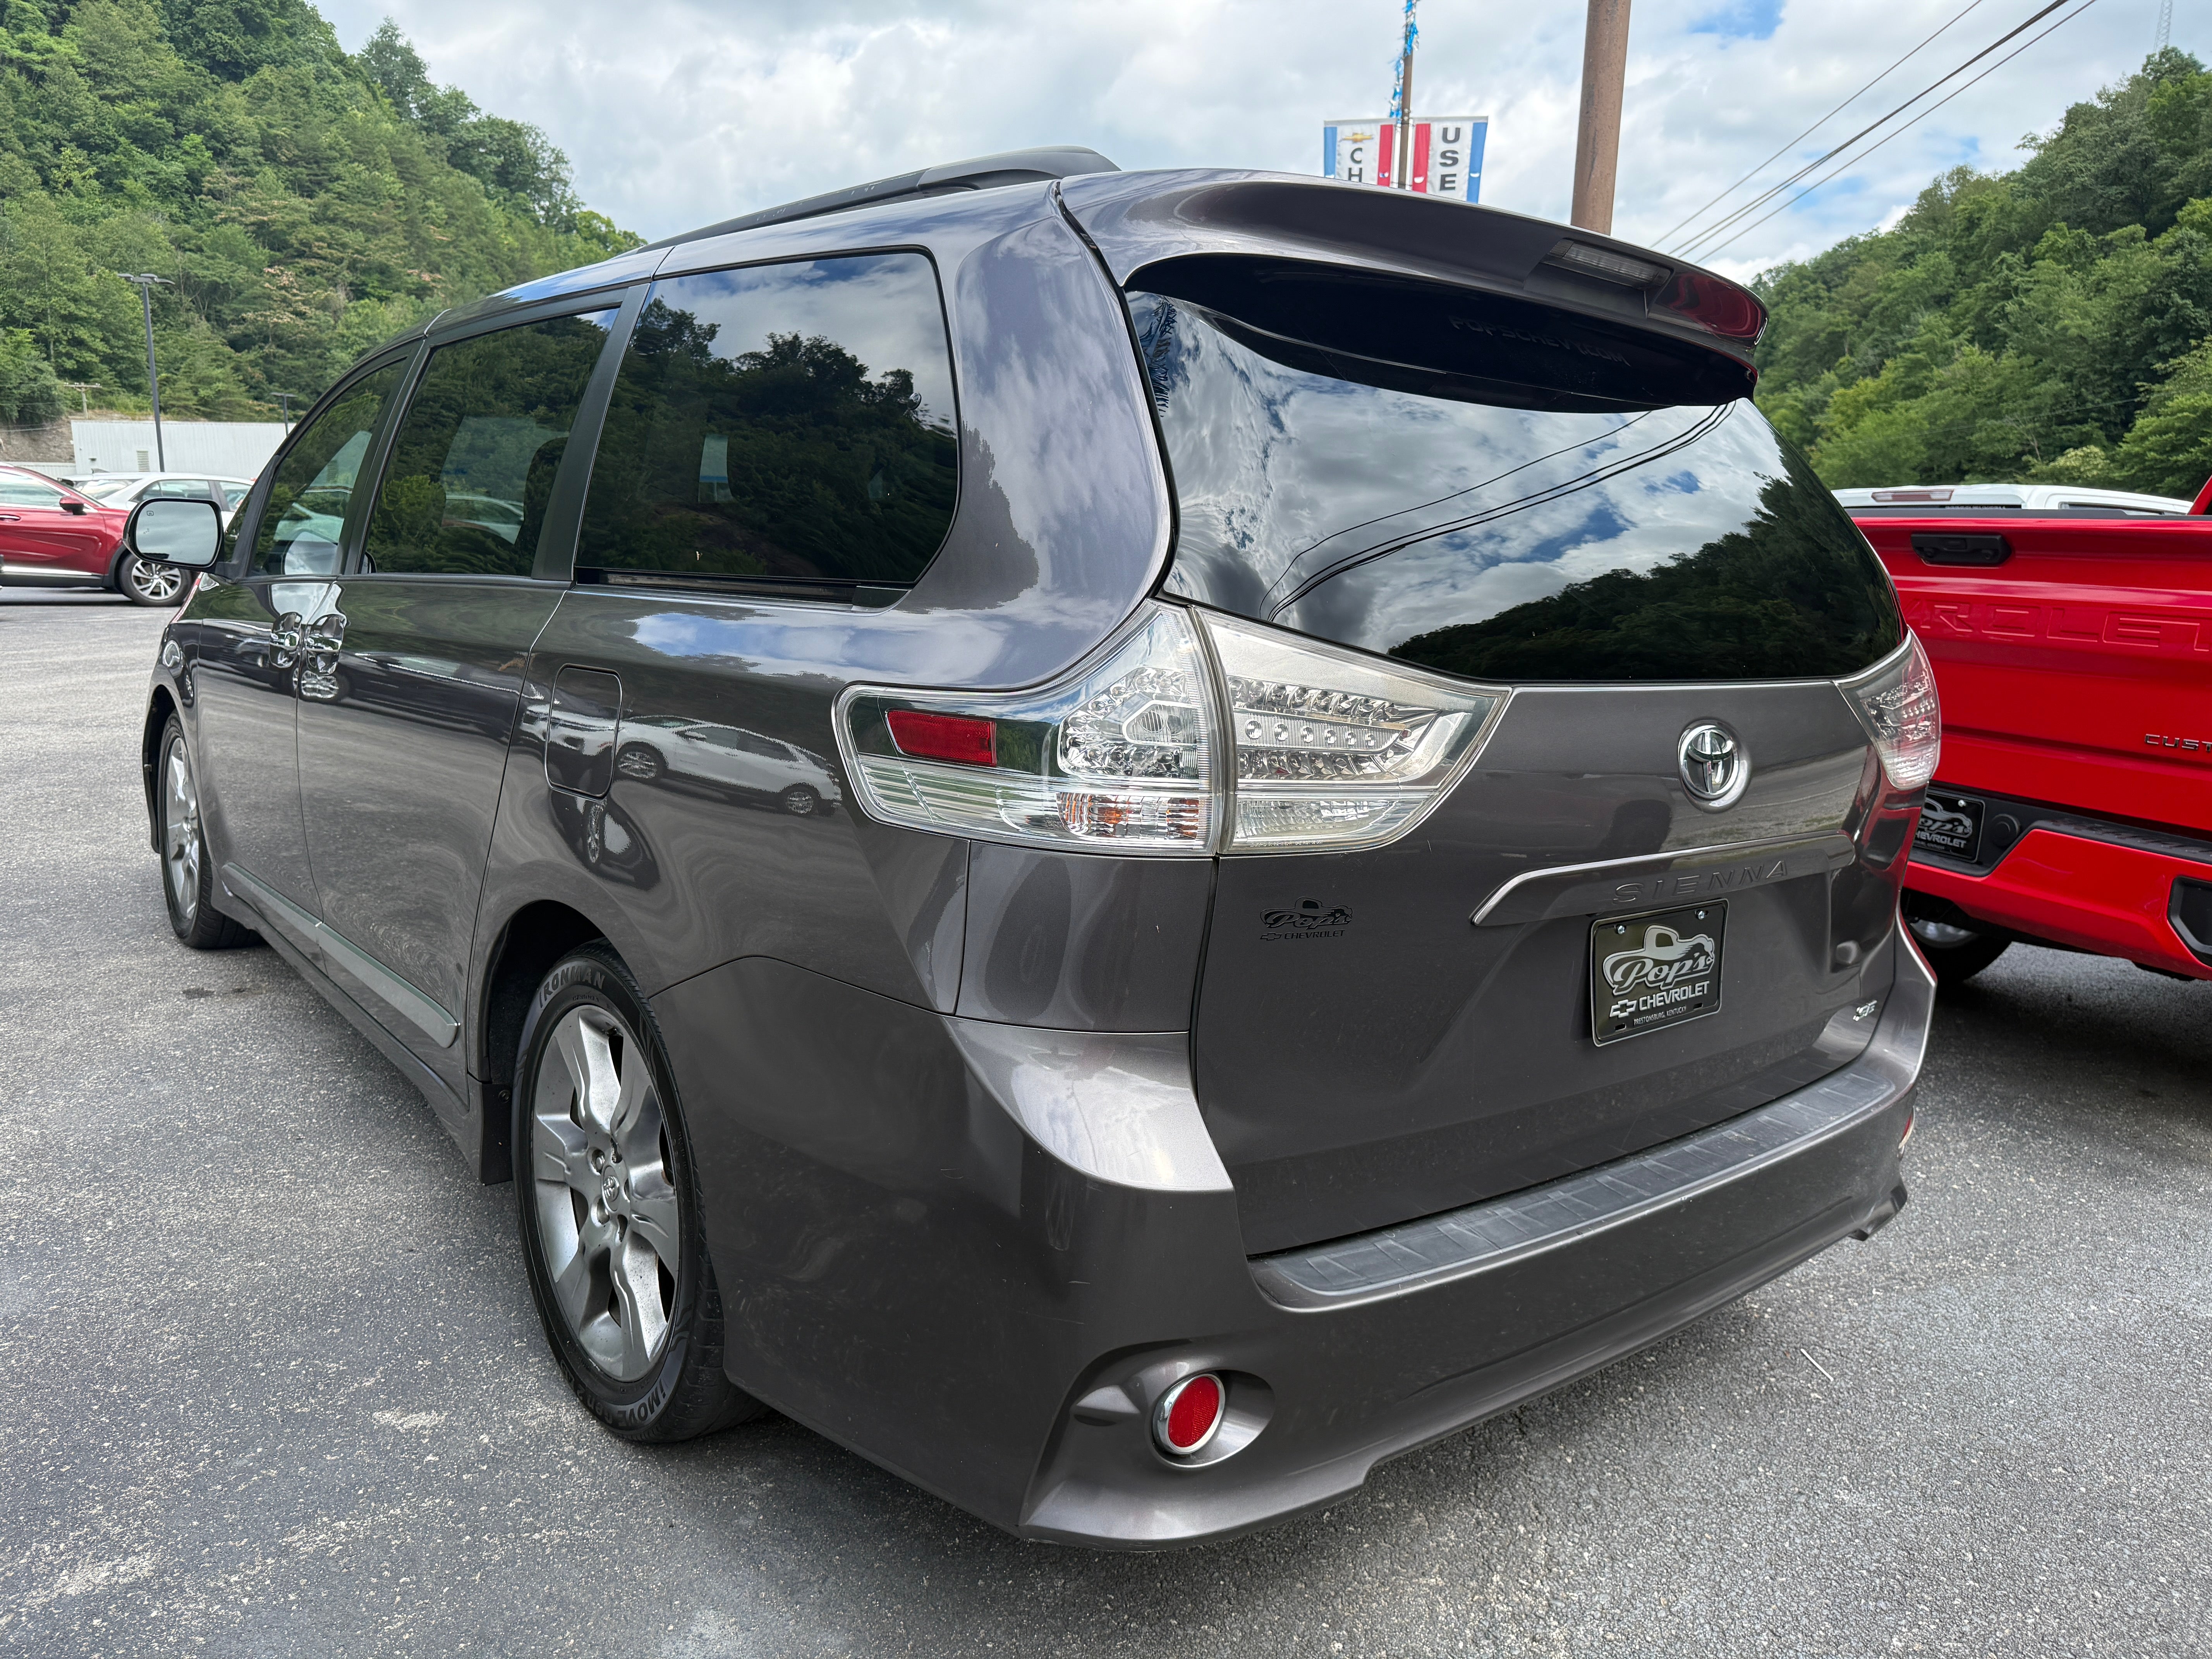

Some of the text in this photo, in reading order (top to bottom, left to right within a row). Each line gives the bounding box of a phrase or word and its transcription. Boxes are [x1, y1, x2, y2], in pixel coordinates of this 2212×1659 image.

[1612, 860, 1788, 905] SIENNA
[1284, 929, 1345, 939] CHEVROLET
[539, 965, 606, 1008] IRONMAN
[1613, 952, 1709, 988] Pop's
[1639, 981, 1710, 1011] CHEVROLET
[1666, 1006, 1686, 1017] KENTUCKY
